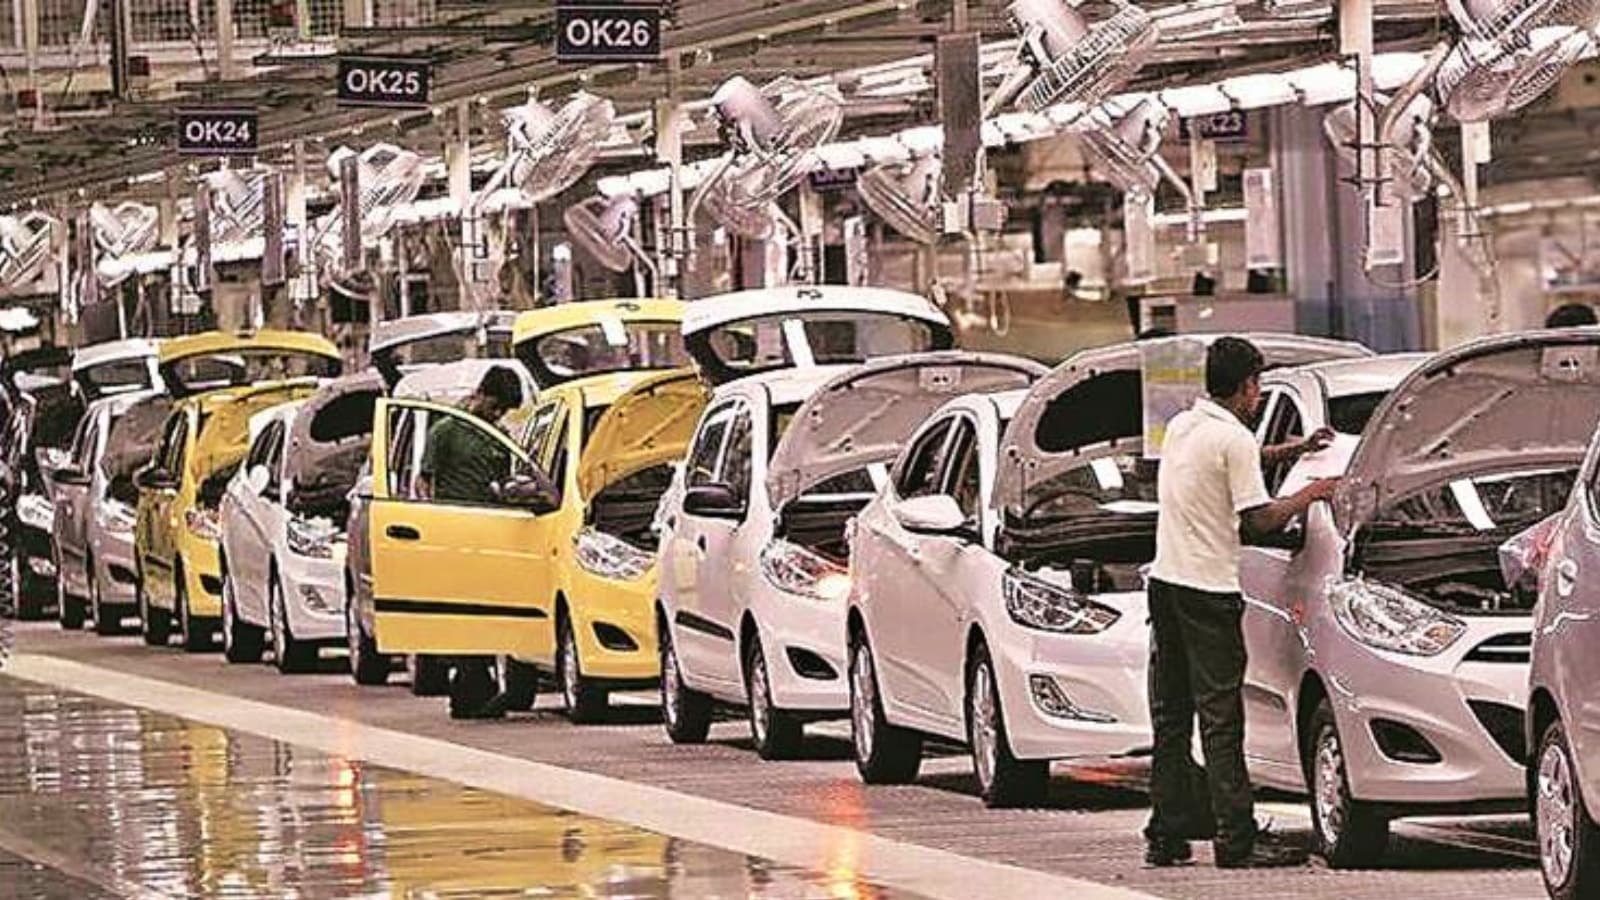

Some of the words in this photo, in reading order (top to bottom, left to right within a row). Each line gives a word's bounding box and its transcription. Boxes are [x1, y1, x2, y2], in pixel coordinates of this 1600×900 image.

[566, 19, 650, 46] OK26
[346, 68, 420, 95] OK25
[185, 120, 250, 142] OK24
